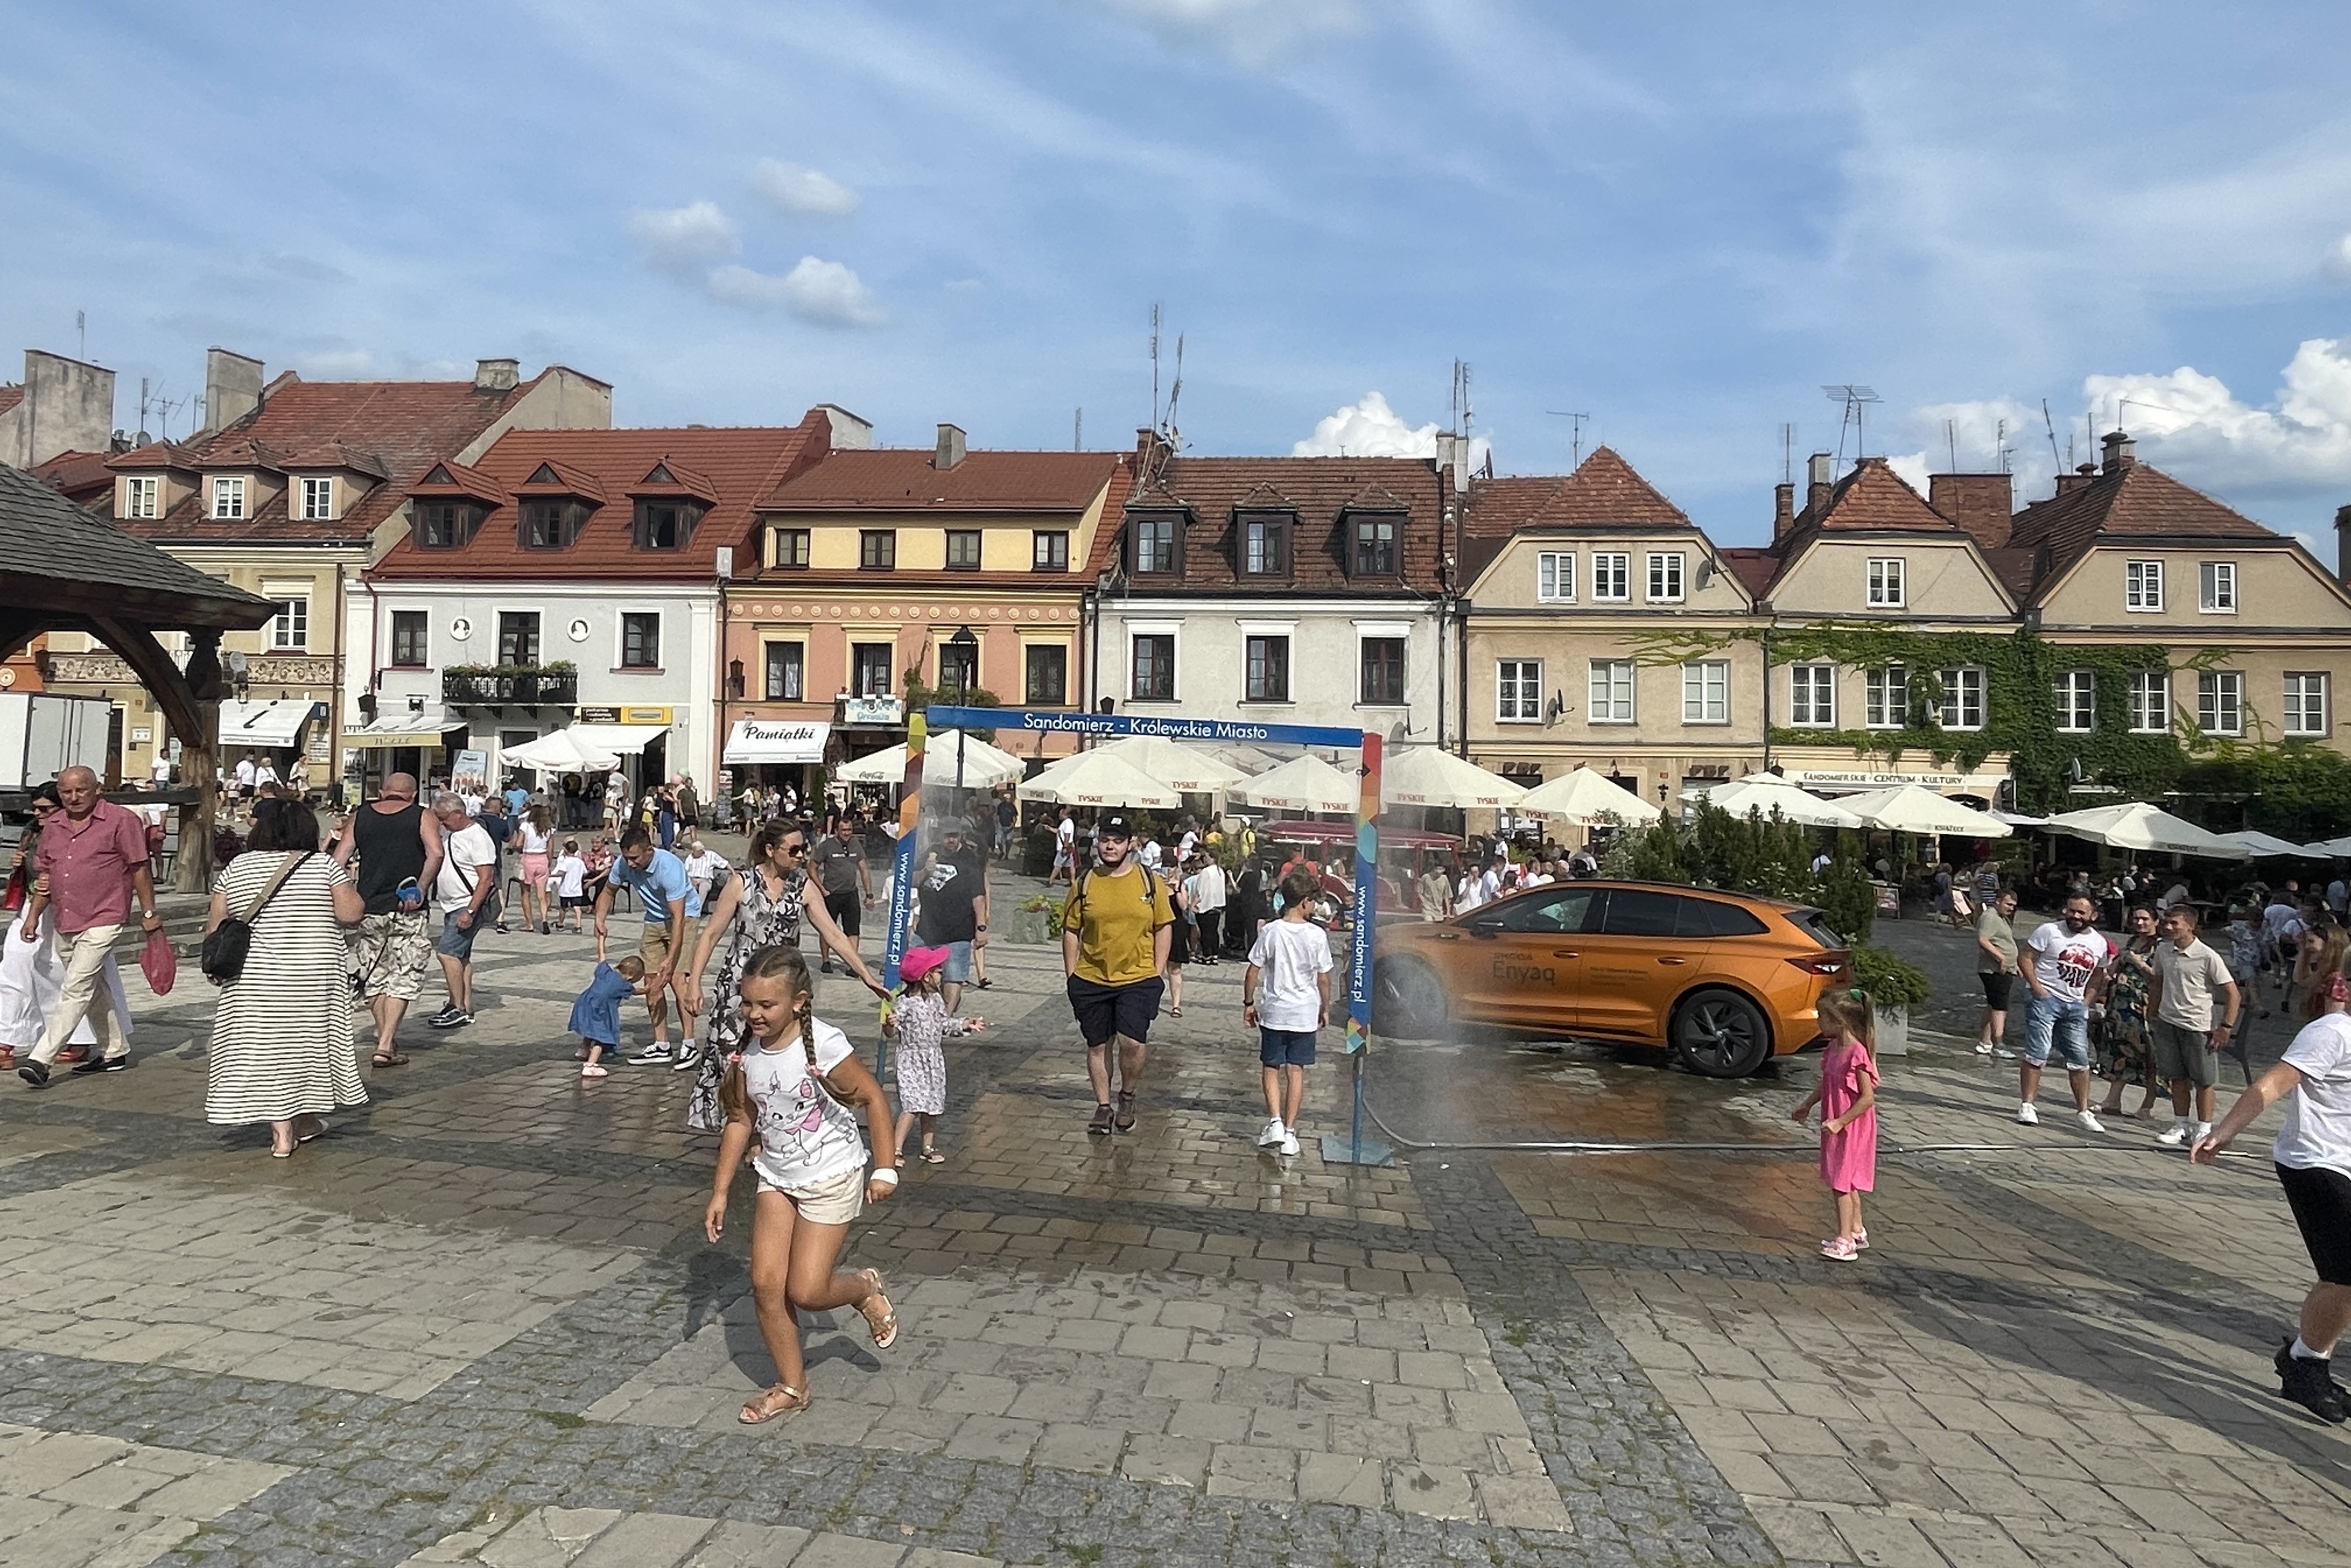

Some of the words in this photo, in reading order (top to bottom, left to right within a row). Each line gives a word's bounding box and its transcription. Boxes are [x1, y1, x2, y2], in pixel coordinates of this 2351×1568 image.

[1024, 713, 1114, 732] Sandomierz
[1130, 718, 1212, 737] Królewskie
[1216, 723, 1268, 739] Miasto
[745, 726, 815, 743] Pamiątki
[1922, 775, 1963, 784] KULTURY
[1172, 781, 1198, 789] TYSKIE
[1078, 794, 1104, 803] TYSKIE
[1261, 797, 1289, 807] TYSKIE
[1397, 793, 1426, 803] TYSKIE
[1321, 802, 1349, 811] TYSKIE
[888, 852, 909, 965] www.sandomierz.pl
[1351, 885, 1369, 1003] www.sandomierz.pl
[1493, 961, 1556, 986] Enyaq
